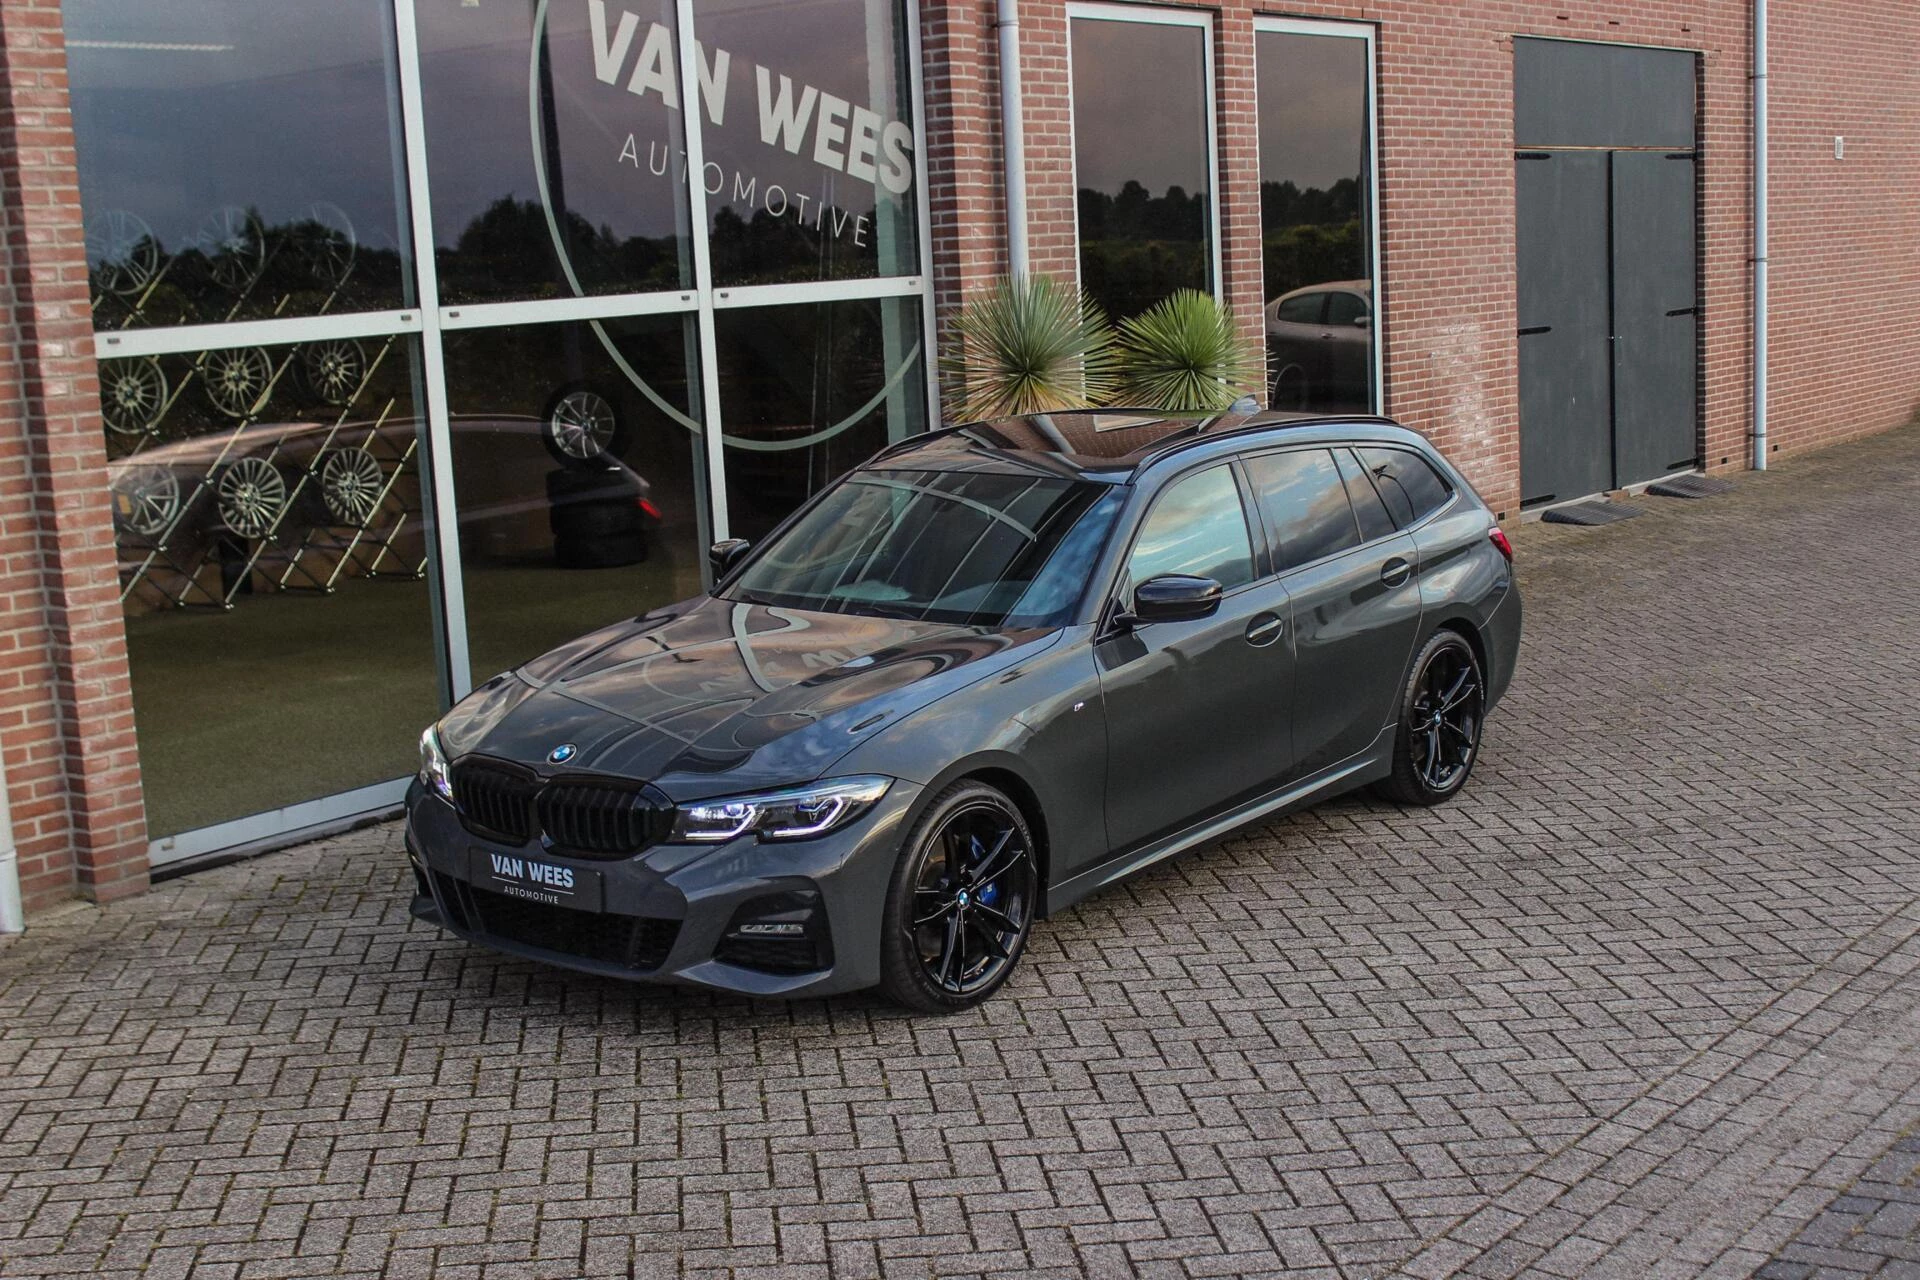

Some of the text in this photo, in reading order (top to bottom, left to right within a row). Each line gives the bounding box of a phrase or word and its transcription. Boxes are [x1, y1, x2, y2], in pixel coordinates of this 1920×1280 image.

[588, 0, 913, 194] VAN WEES
[618, 133, 870, 248] AUTOMOTIVE
[491, 853, 574, 888] VAN WEES
[504, 885, 559, 904] AUTOMOTIVE
